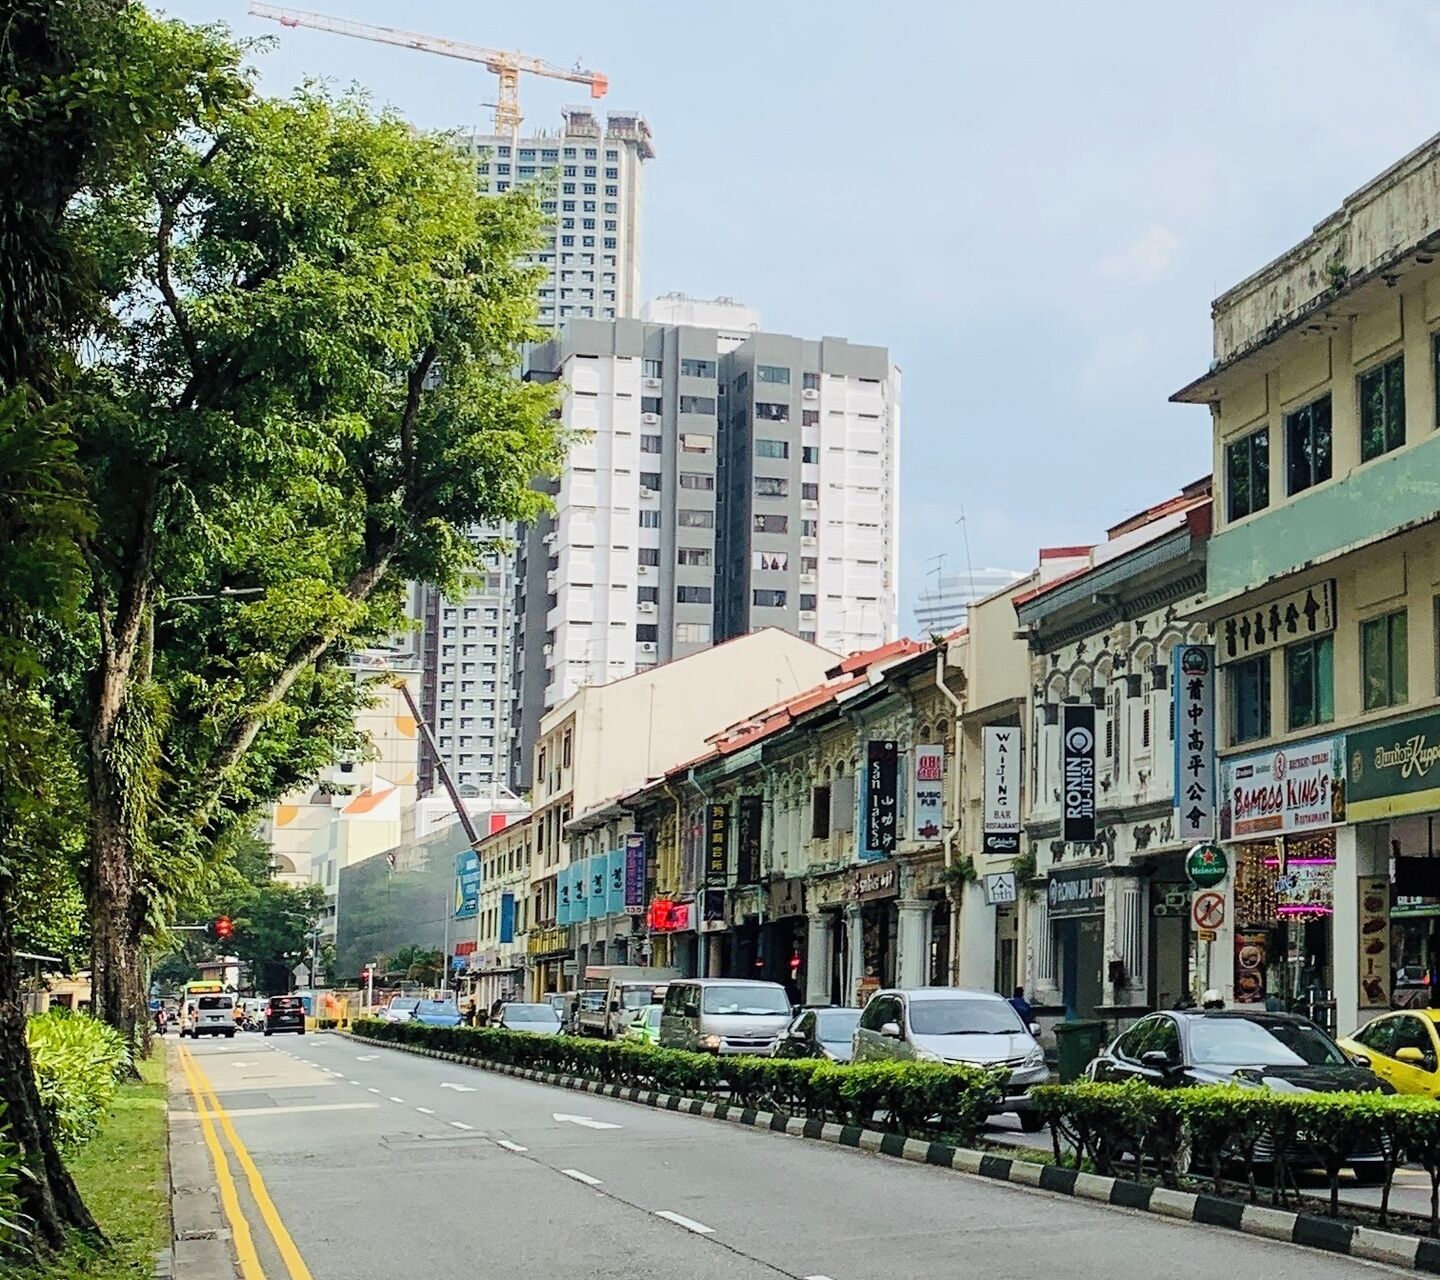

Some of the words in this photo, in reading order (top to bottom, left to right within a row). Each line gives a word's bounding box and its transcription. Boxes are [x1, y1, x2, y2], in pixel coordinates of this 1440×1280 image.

[1374, 742, 1413, 770] Junior
[1066, 757, 1082, 819] RONIN
[1081, 757, 1094, 819] JIU-JITSU
[1233, 782, 1284, 820] BAMBOO
[1286, 768, 1330, 810] KING'S
[921, 799, 936, 807] PUB
[993, 810, 1011, 820] BAR
[871, 794, 880, 848] laksa
[1294, 811, 1330, 826] RESTAURANT
[1079, 877, 1105, 900] JIU-JITS
